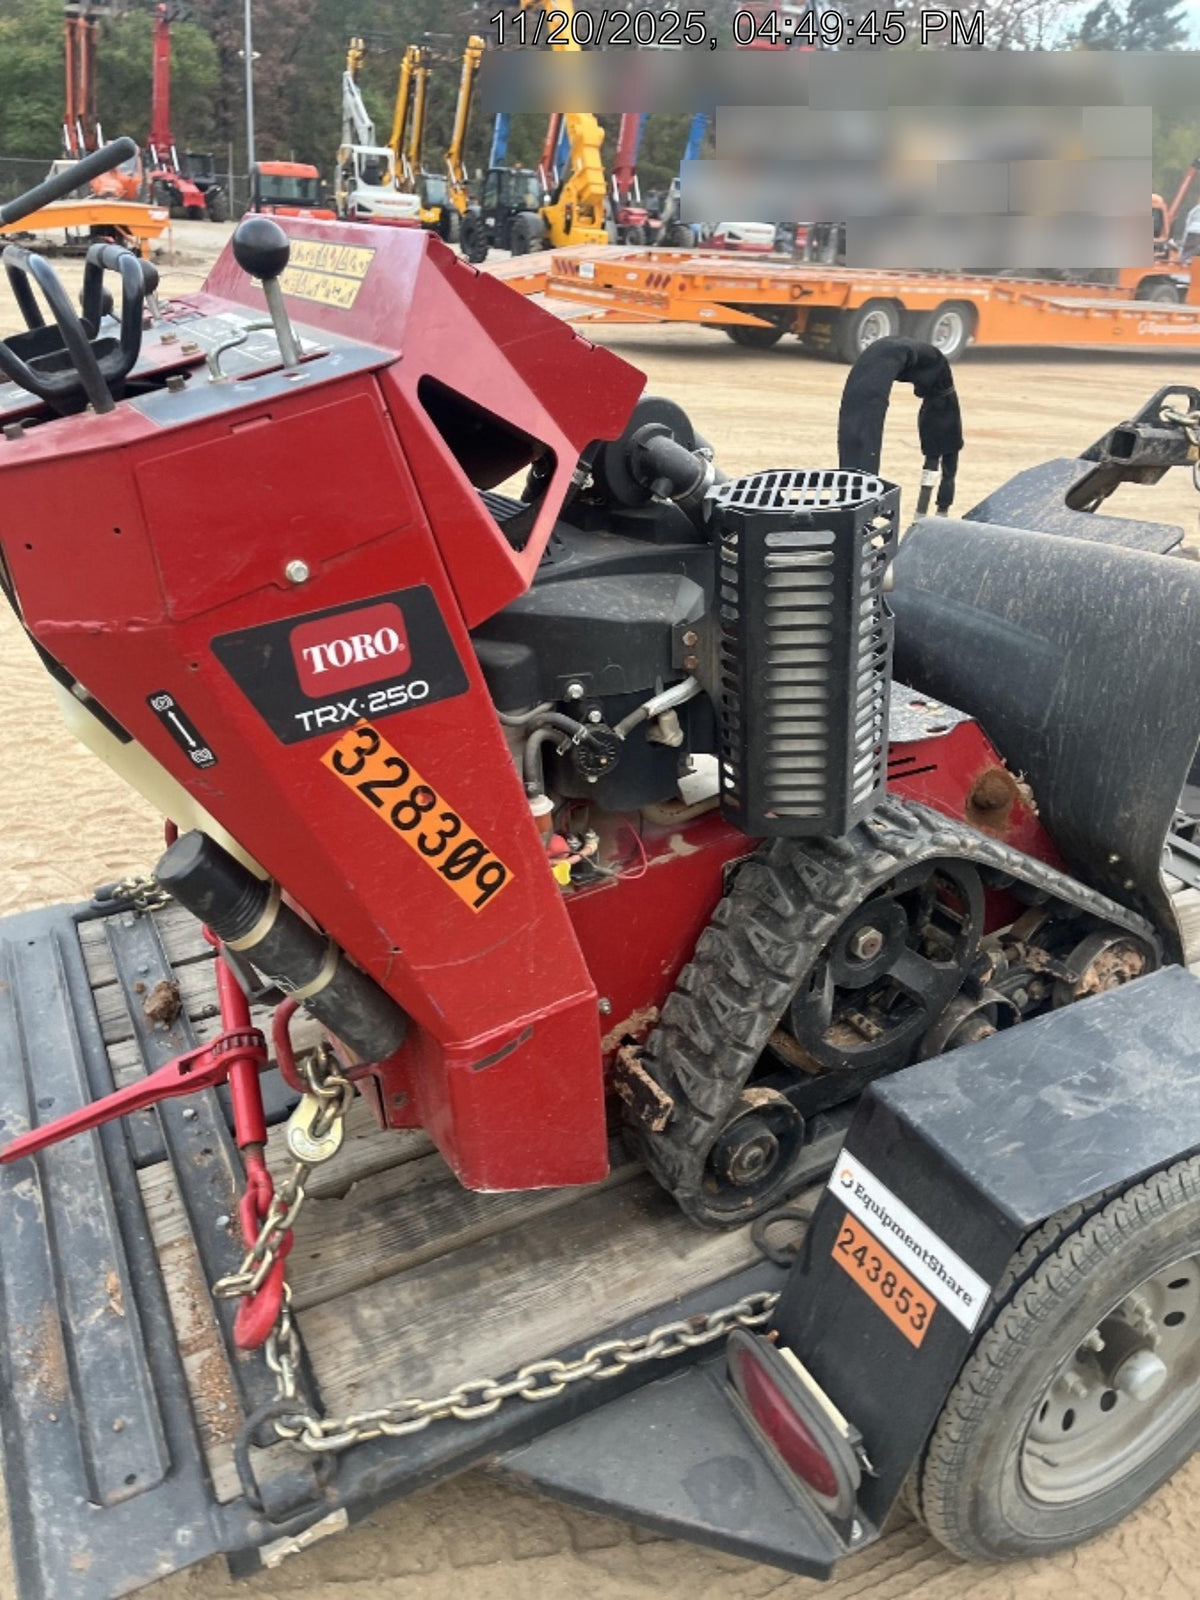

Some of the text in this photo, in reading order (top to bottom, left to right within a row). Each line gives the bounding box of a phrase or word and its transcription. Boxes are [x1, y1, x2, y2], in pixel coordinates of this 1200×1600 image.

[302, 626, 400, 675] TORO
[332, 727, 507, 909] 328309
[838, 1228, 928, 1331] 243853
[854, 1183, 973, 1308] EquipmentShare
